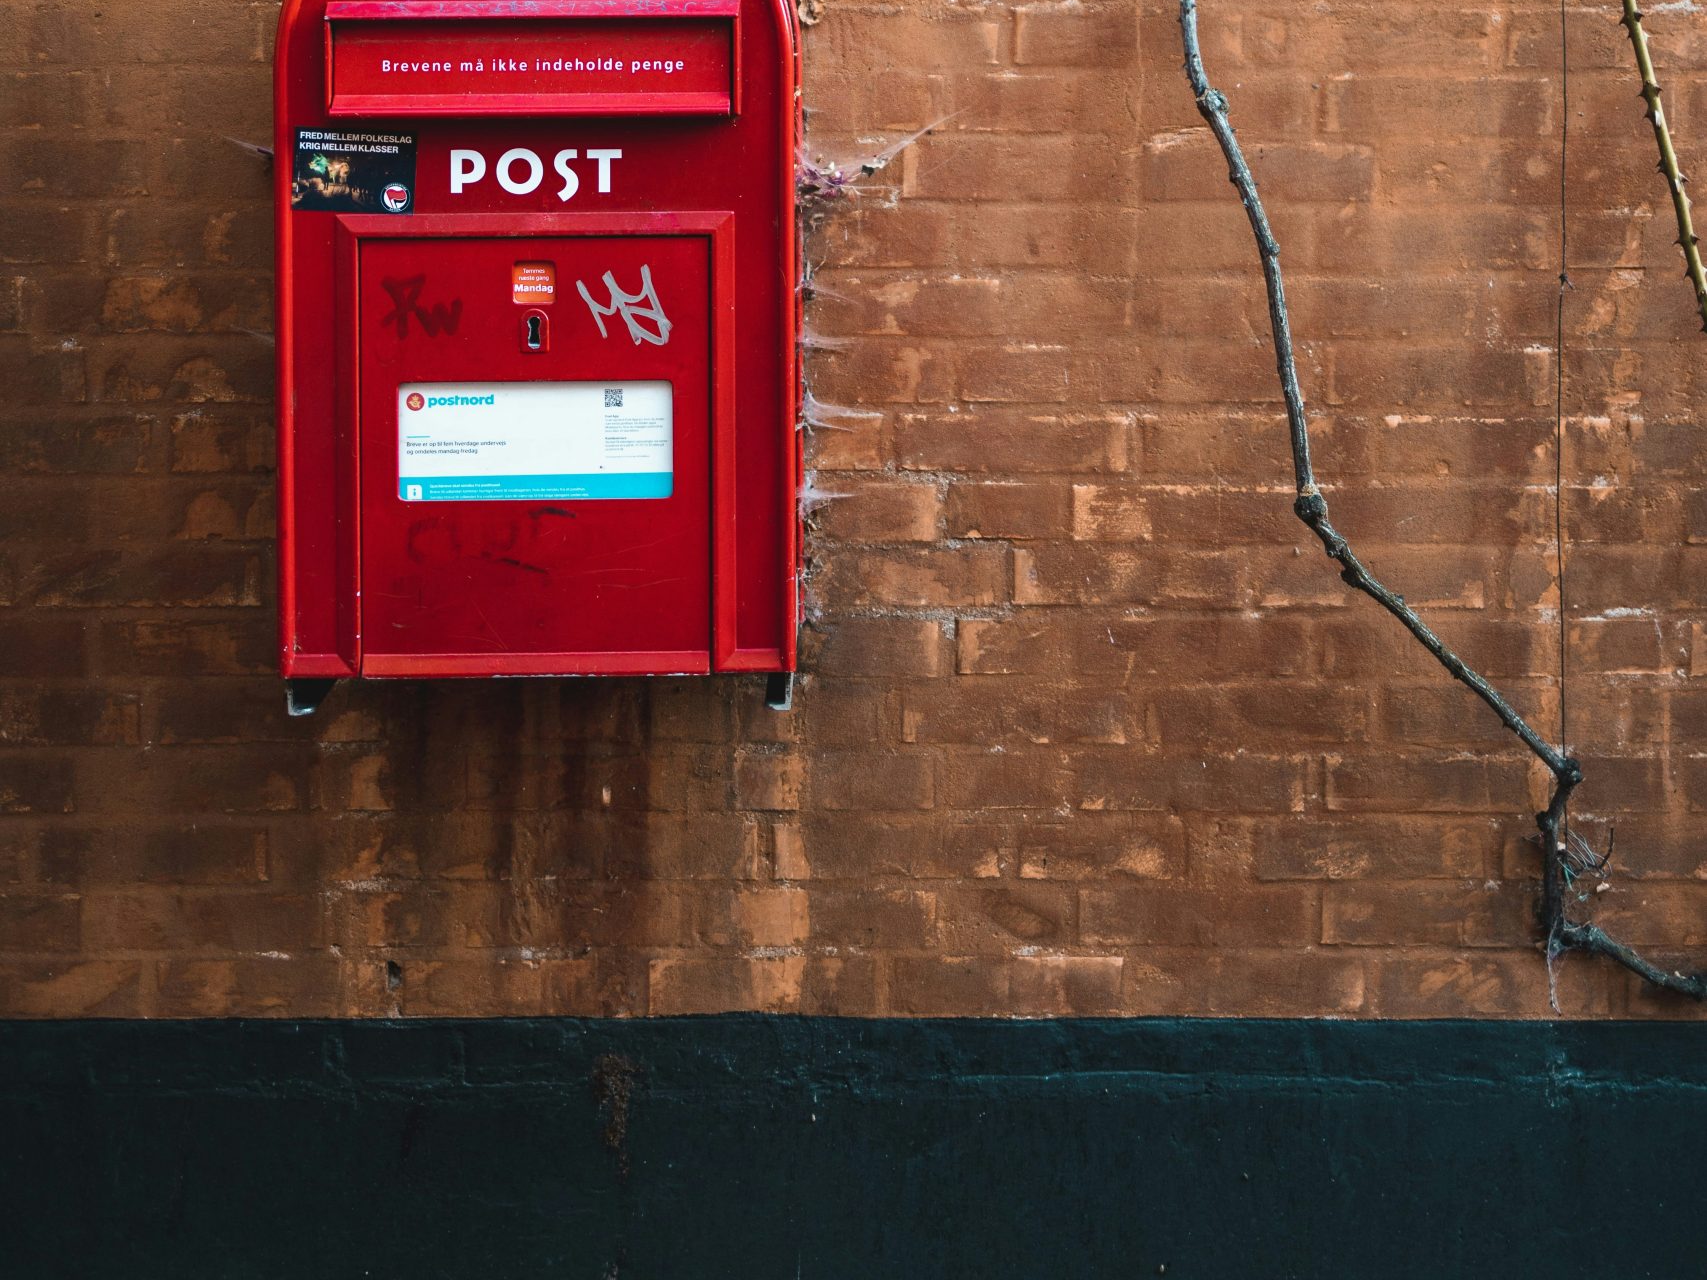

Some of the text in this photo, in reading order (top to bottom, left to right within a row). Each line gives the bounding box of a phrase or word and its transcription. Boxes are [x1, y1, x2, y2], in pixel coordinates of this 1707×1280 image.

[382, 58, 685, 73] Brevene må ikke indeholde penge
[300, 131, 412, 144] FRED MELLEM FOLKESLAG
[299, 142, 399, 154] KRIG MELLEM KLASSER
[450, 147, 623, 202] POST
[514, 284, 554, 294] Mandag
[428, 394, 495, 408] postnord
